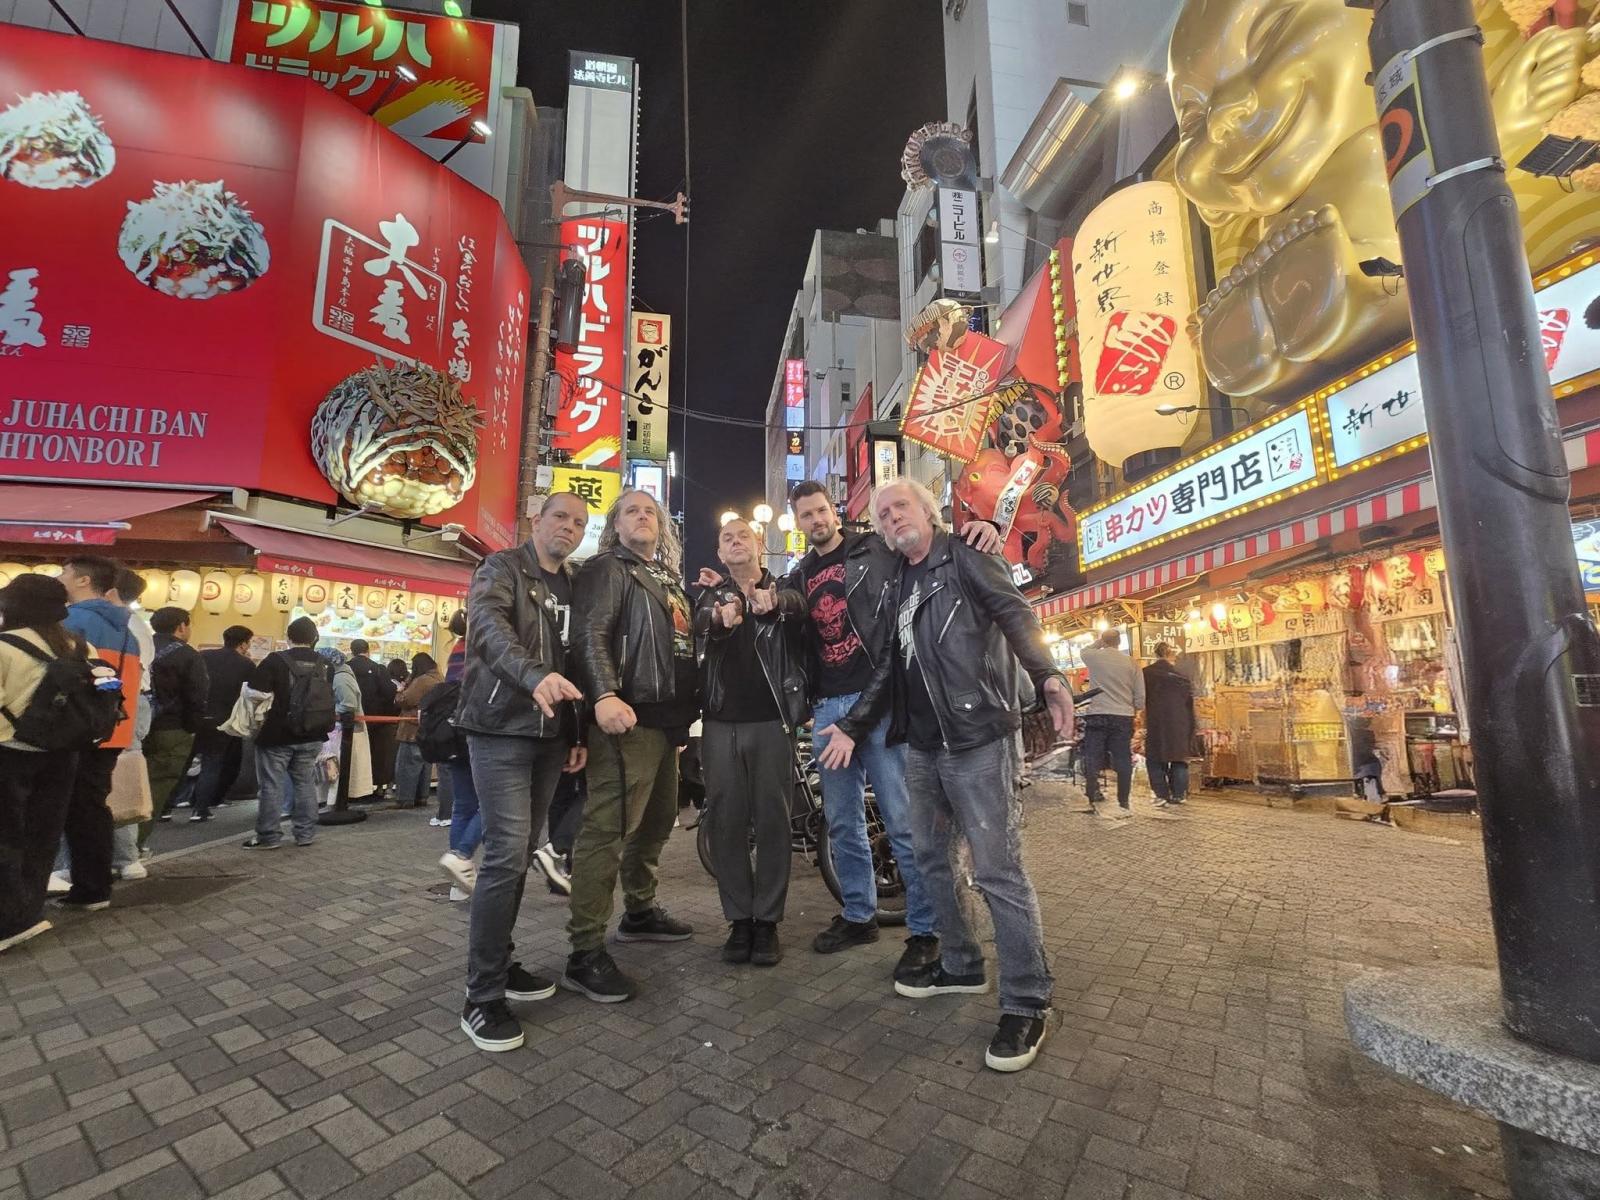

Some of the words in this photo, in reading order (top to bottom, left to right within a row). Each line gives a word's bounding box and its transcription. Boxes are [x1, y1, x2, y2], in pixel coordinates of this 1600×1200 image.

[251, 1, 432, 68] ツルハ
[1090, 230, 1130, 317] 新世界
[1147, 201, 1174, 306] 商標登録
[634, 344, 668, 415] がんこ
[1104, 451, 1264, 543] 串カツ専門店
[1163, 626, 1183, 636] EAT
